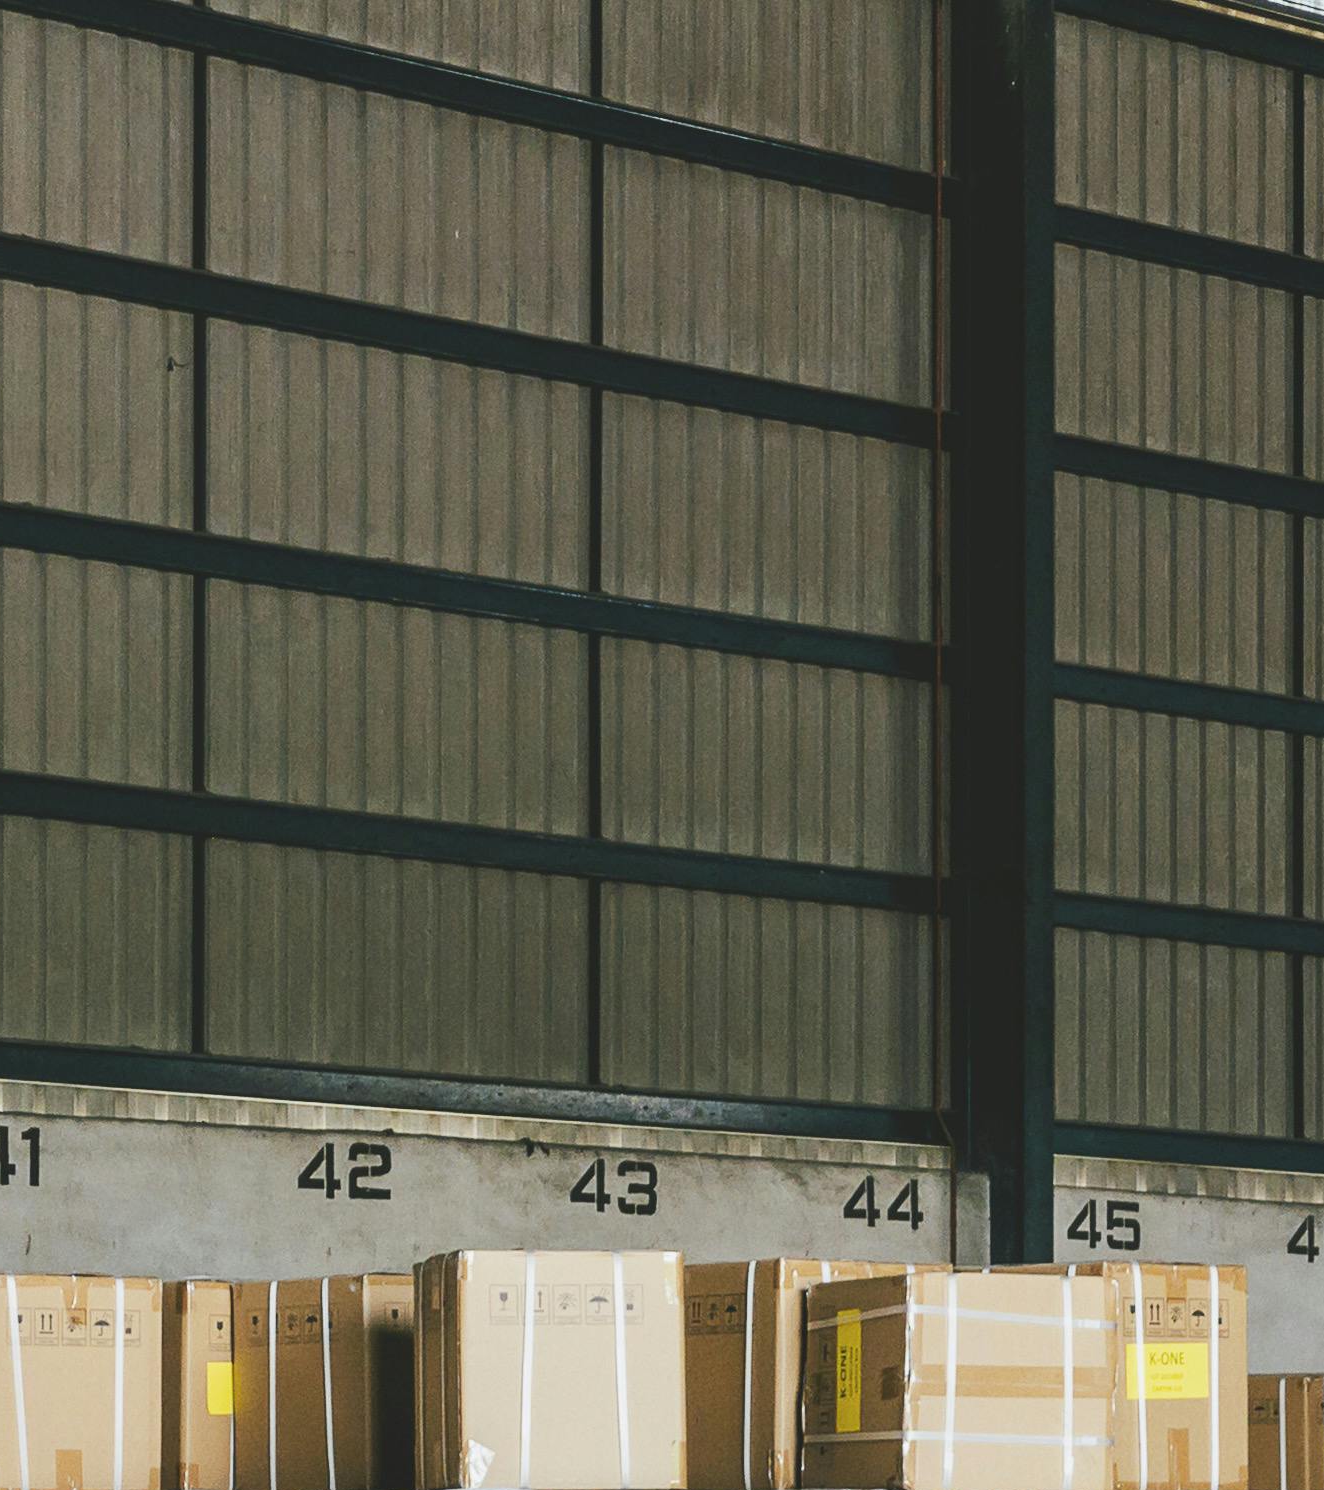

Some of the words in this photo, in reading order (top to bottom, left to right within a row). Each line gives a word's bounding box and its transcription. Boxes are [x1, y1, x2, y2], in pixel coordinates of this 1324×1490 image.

[297, 1140, 392, 1201] 42
[569, 1157, 657, 1216] 43
[843, 1177, 924, 1231] 44
[1067, 1198, 1141, 1251] 45
[1149, 1351, 1186, 1366] K-ONE
